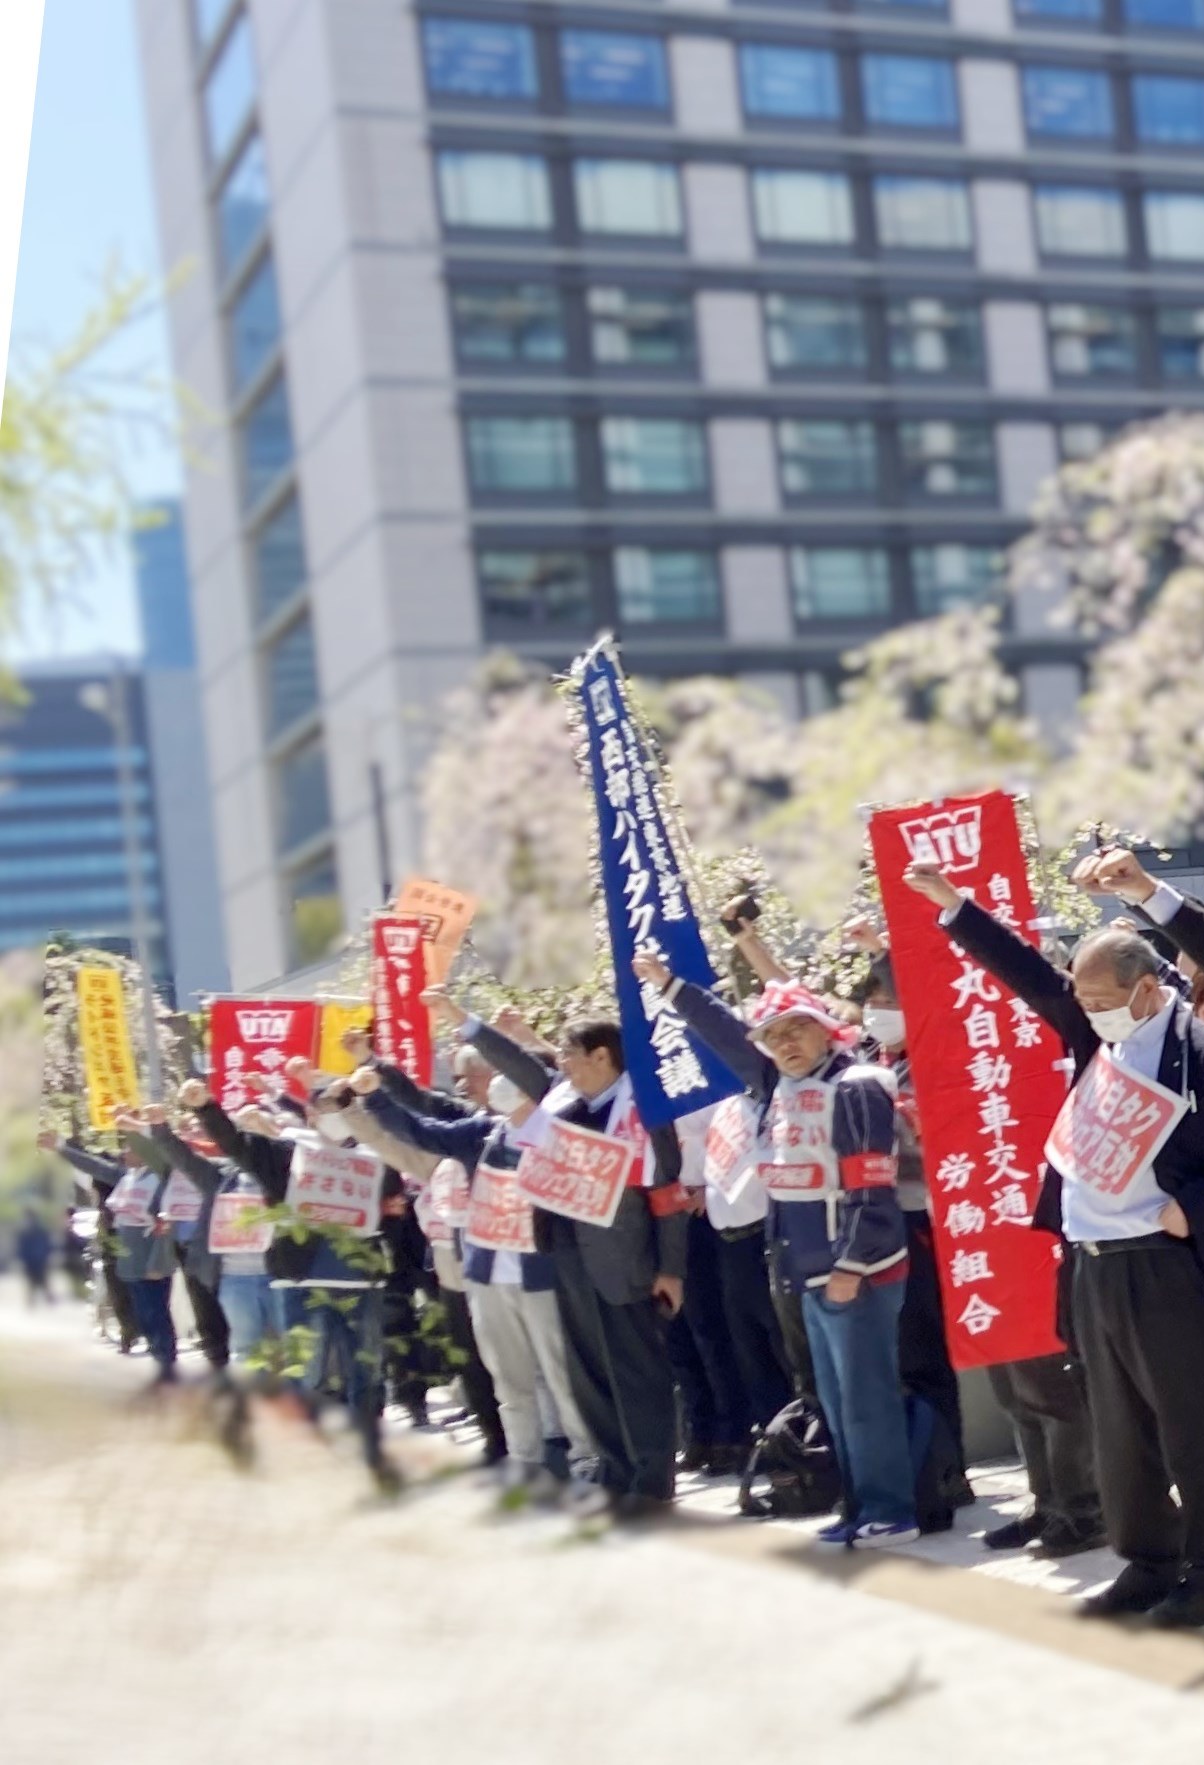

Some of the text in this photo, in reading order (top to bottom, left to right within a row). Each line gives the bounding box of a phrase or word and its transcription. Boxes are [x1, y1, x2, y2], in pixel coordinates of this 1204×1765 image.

[950, 886, 1034, 1226] 丸自動車交通
[936, 1153, 1001, 1336] 労働組合
